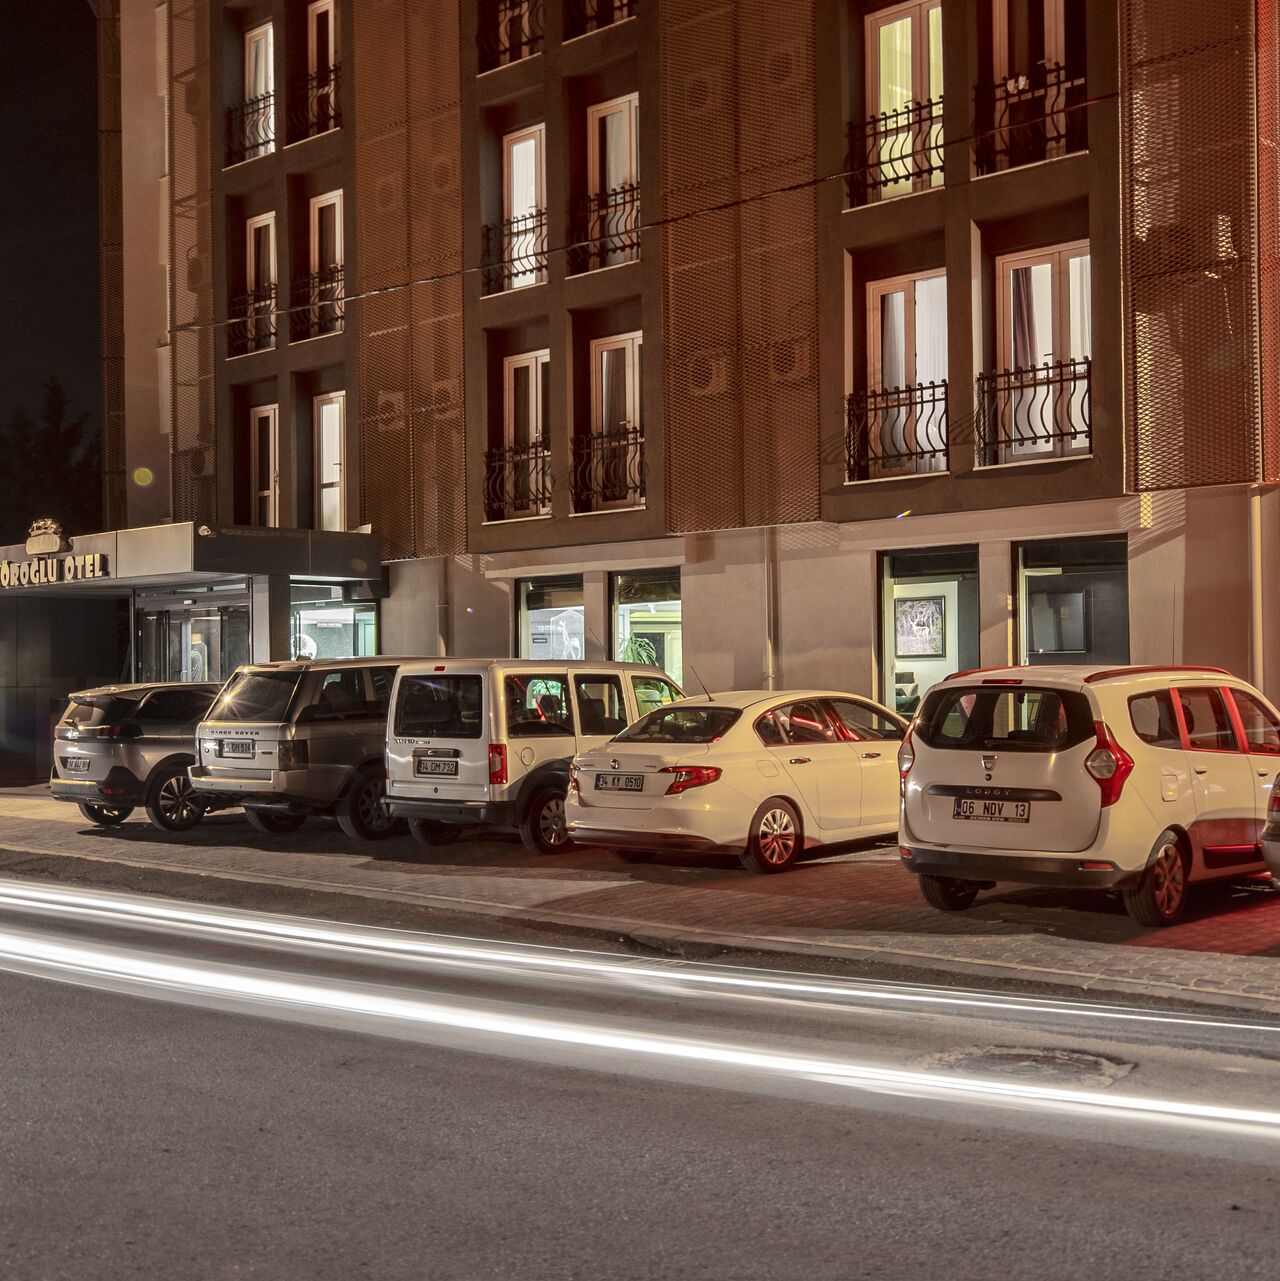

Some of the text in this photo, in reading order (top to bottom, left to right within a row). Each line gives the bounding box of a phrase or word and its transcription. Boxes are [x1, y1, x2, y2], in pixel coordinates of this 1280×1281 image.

[64, 553, 103, 581] OTEL
[442, 763, 454, 773] 732
[600, 776, 641, 788] 34 KY 0510
[966, 788, 1012, 796] LODGY
[962, 801, 1026, 817] 06 NDV 13
